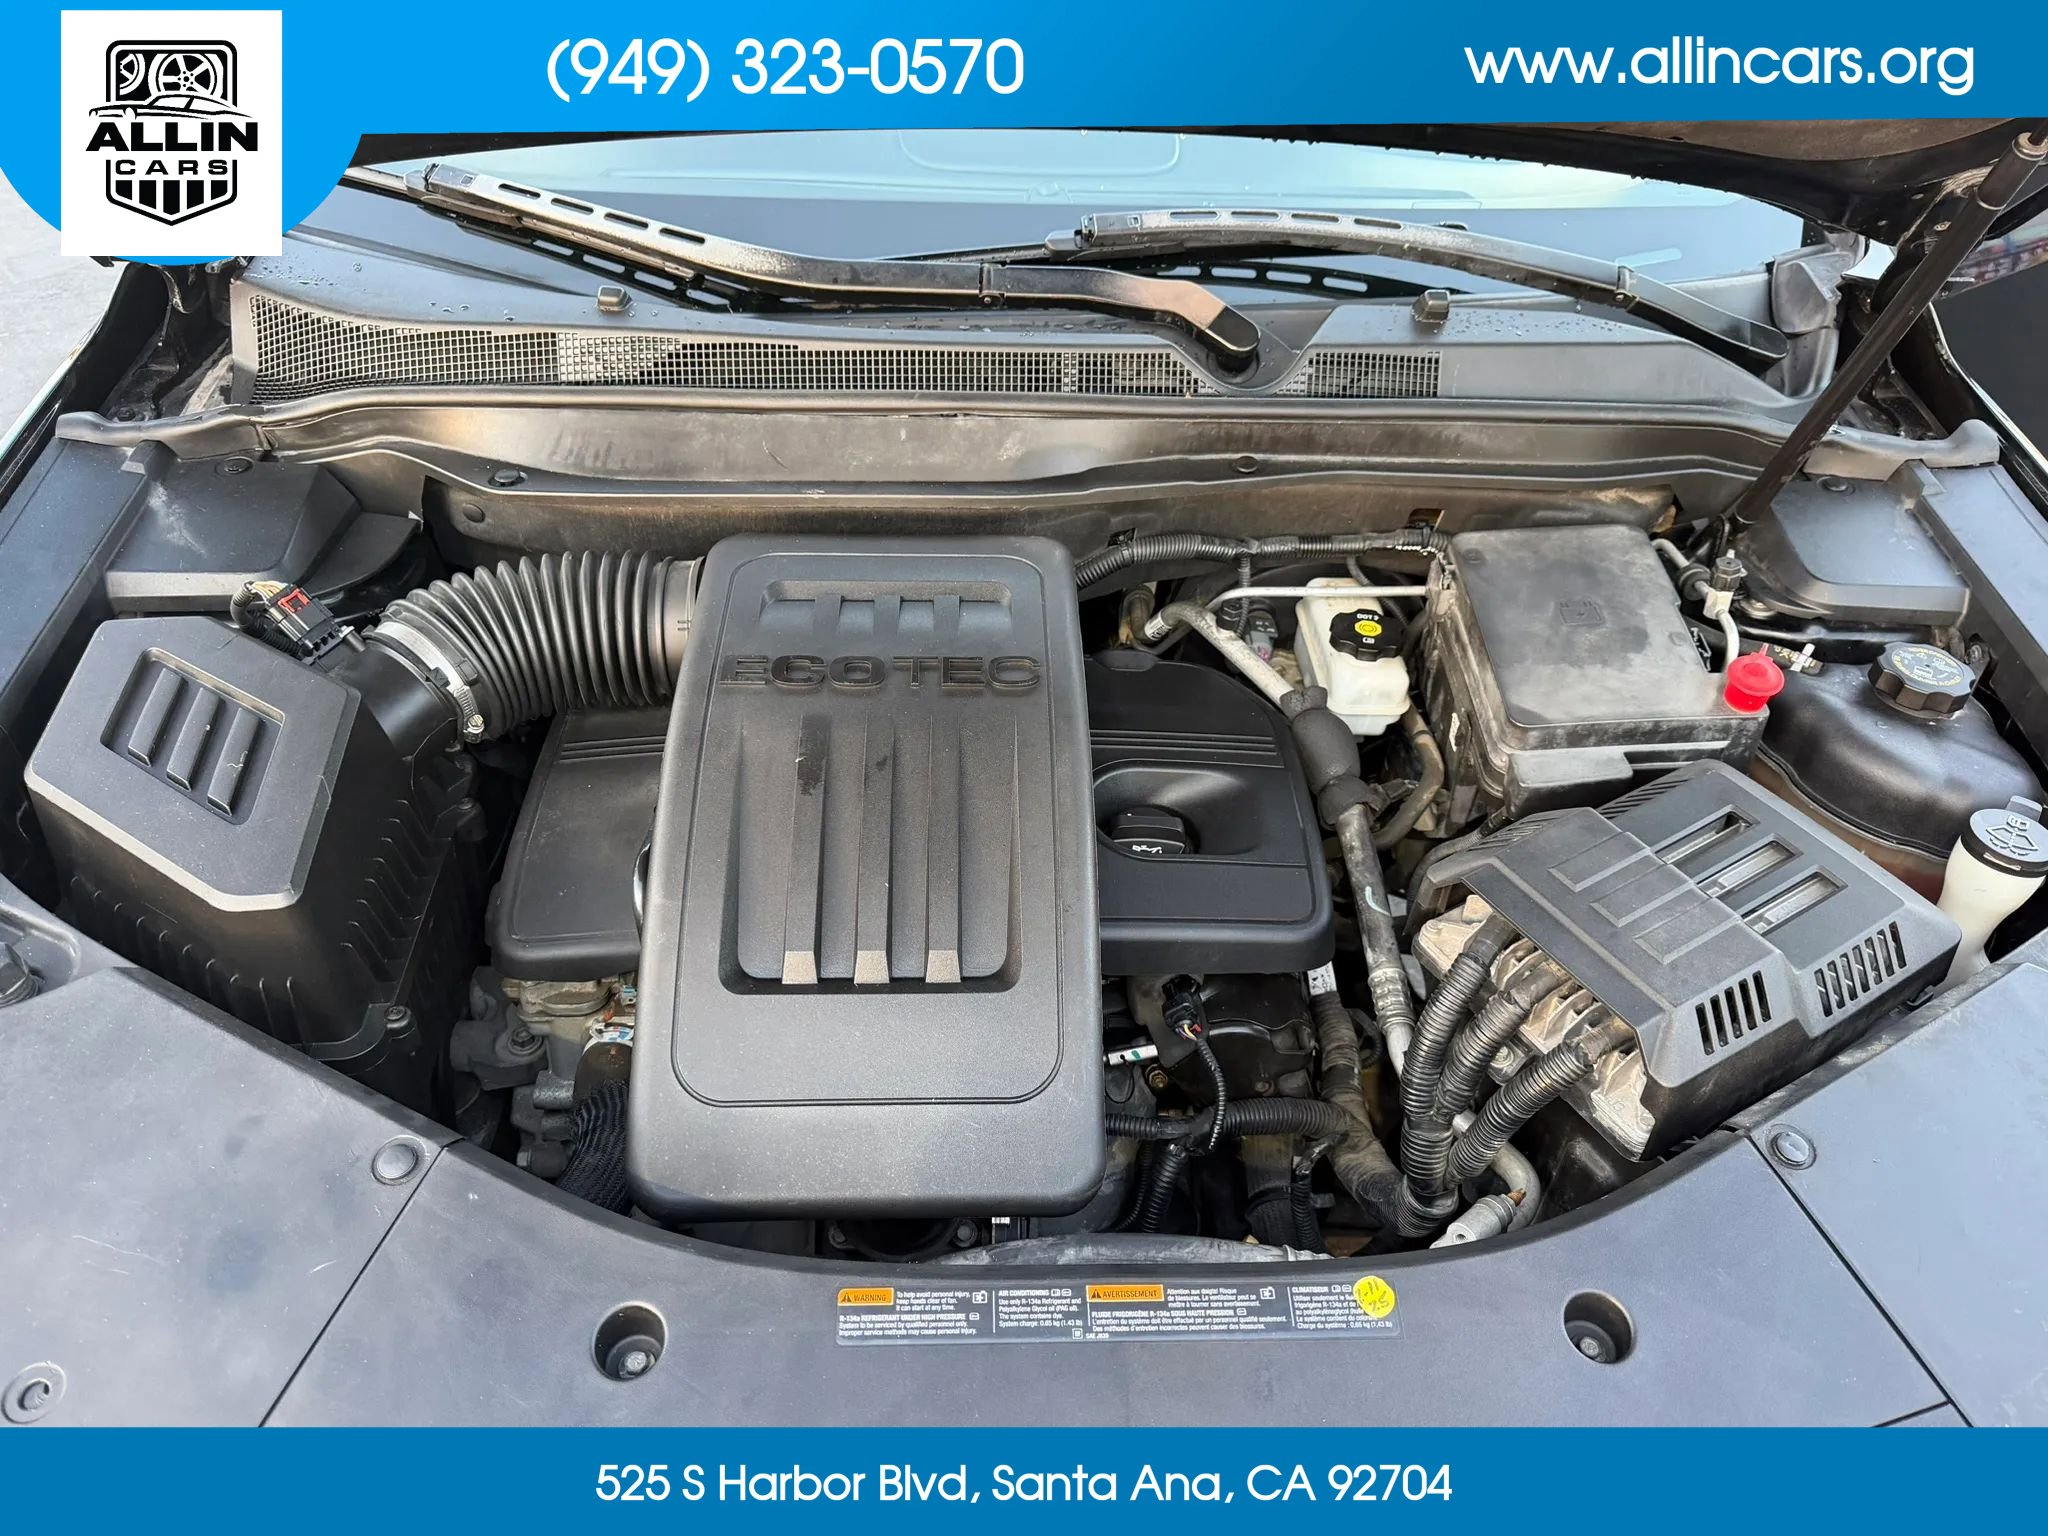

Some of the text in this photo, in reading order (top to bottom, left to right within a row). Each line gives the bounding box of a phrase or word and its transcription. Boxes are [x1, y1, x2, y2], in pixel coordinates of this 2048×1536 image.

[719, 653, 1042, 690] ECOTEC
[854, 1294, 886, 1302] WARNING
[904, 1291, 916, 1299] help
[931, 1291, 954, 1299] personal
[1103, 1290, 1157, 1298] AVERTISSEMENT
[905, 1321, 928, 1329] qualified
[1297, 1322, 1316, 1330] Charge
